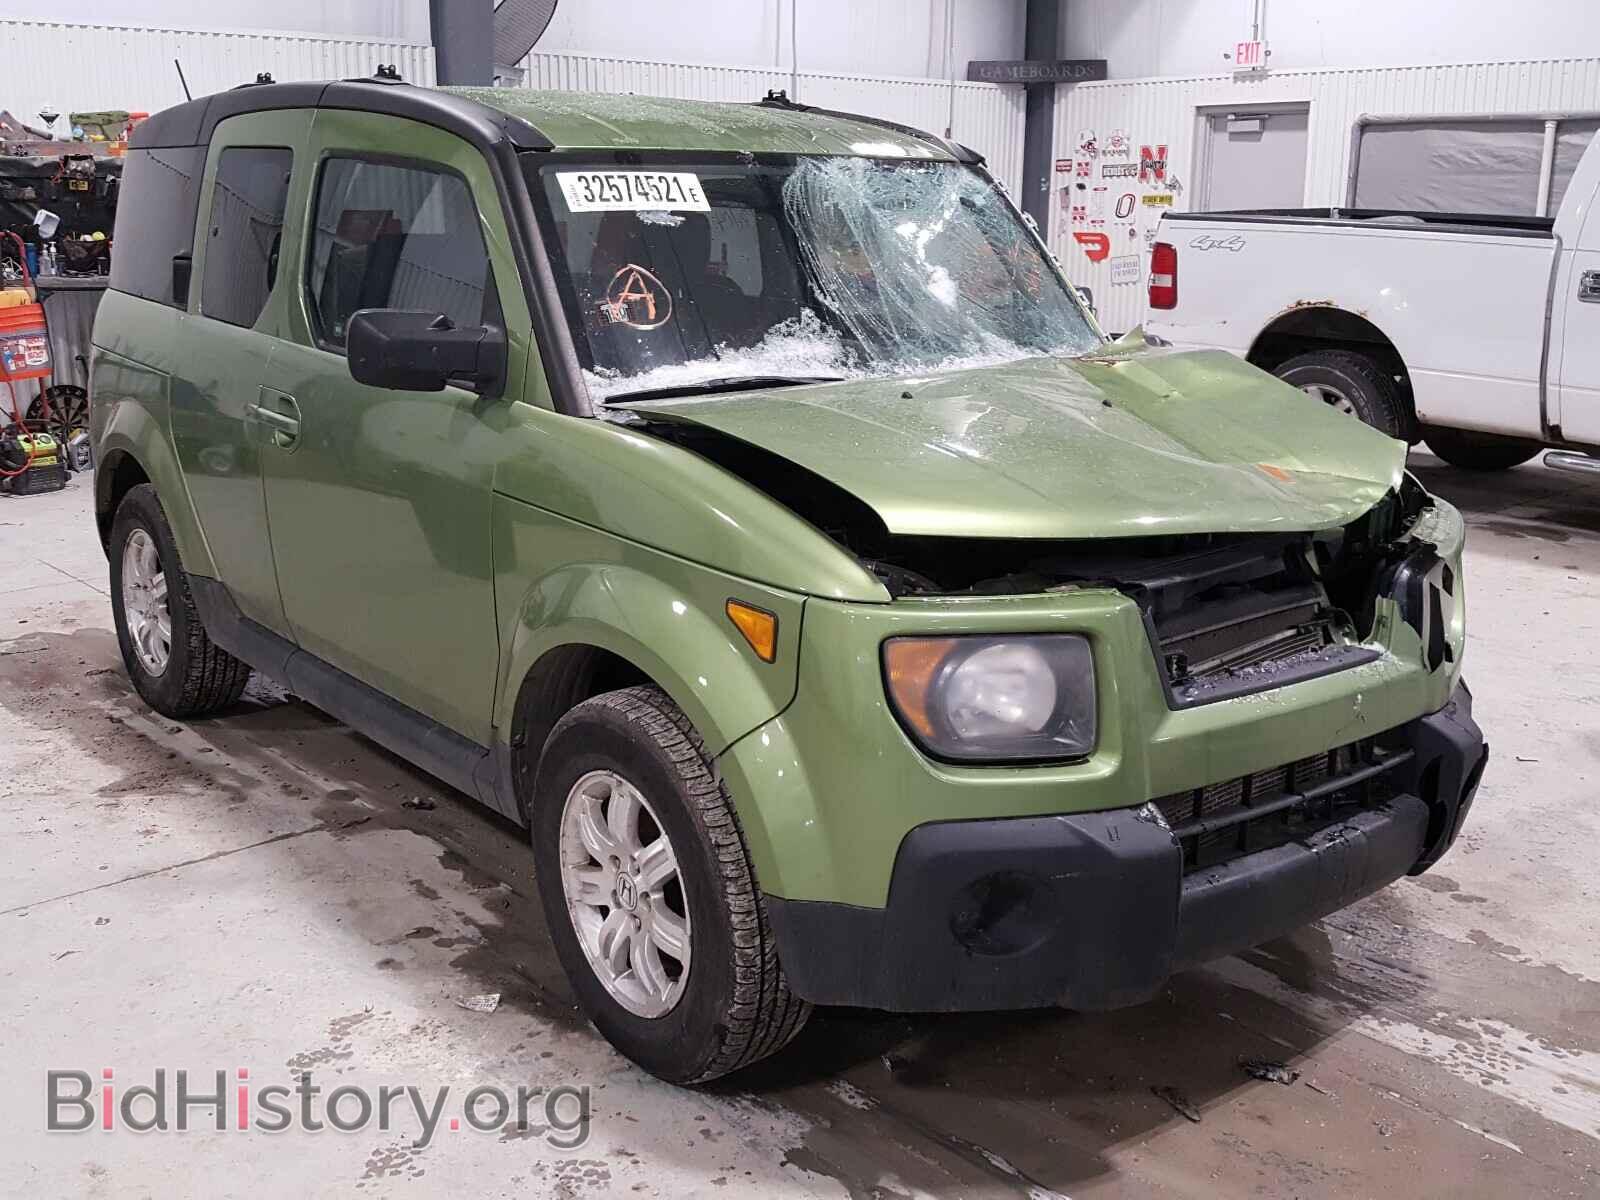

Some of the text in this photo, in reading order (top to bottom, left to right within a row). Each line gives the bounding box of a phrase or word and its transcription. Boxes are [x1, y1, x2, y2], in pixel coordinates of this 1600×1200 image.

[1236, 42, 1260, 65] EXIT
[980, 64, 1097, 80] GAMEBOARDS
[577, 174, 688, 203] 32574521
[689, 187, 700, 203] E
[1189, 234, 1246, 252] 4x4
